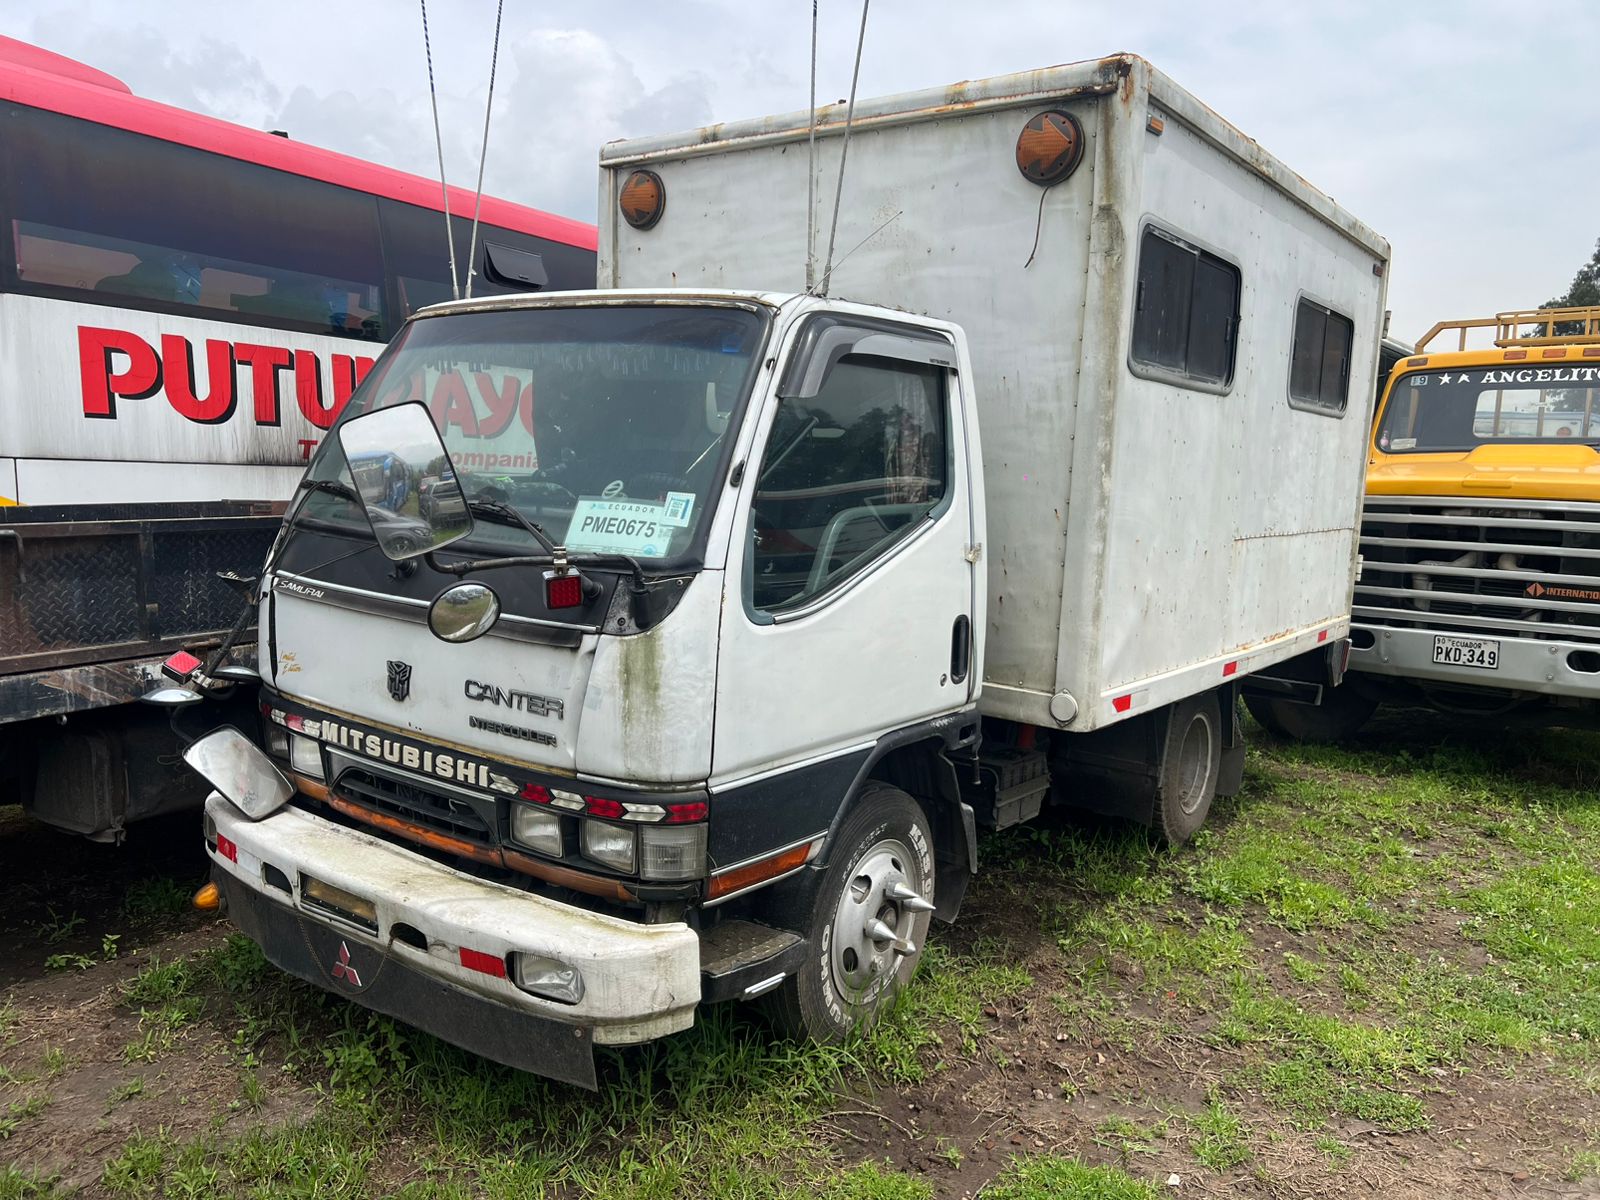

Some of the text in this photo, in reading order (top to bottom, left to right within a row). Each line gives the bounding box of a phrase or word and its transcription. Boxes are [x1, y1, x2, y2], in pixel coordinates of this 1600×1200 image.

[608, 503, 656, 514] ECUADOR
[581, 515, 657, 538] PME0675
[278, 580, 325, 598] SAMURAI
[1546, 587, 1600, 600] INTERNATIO
[1451, 640, 1483, 649] ECUADOR
[1435, 646, 1497, 666] PKD-349
[464, 679, 564, 721] CANTER
[468, 714, 558, 748] INTERCOOLER
[320, 719, 490, 788] MITSUBISHI
